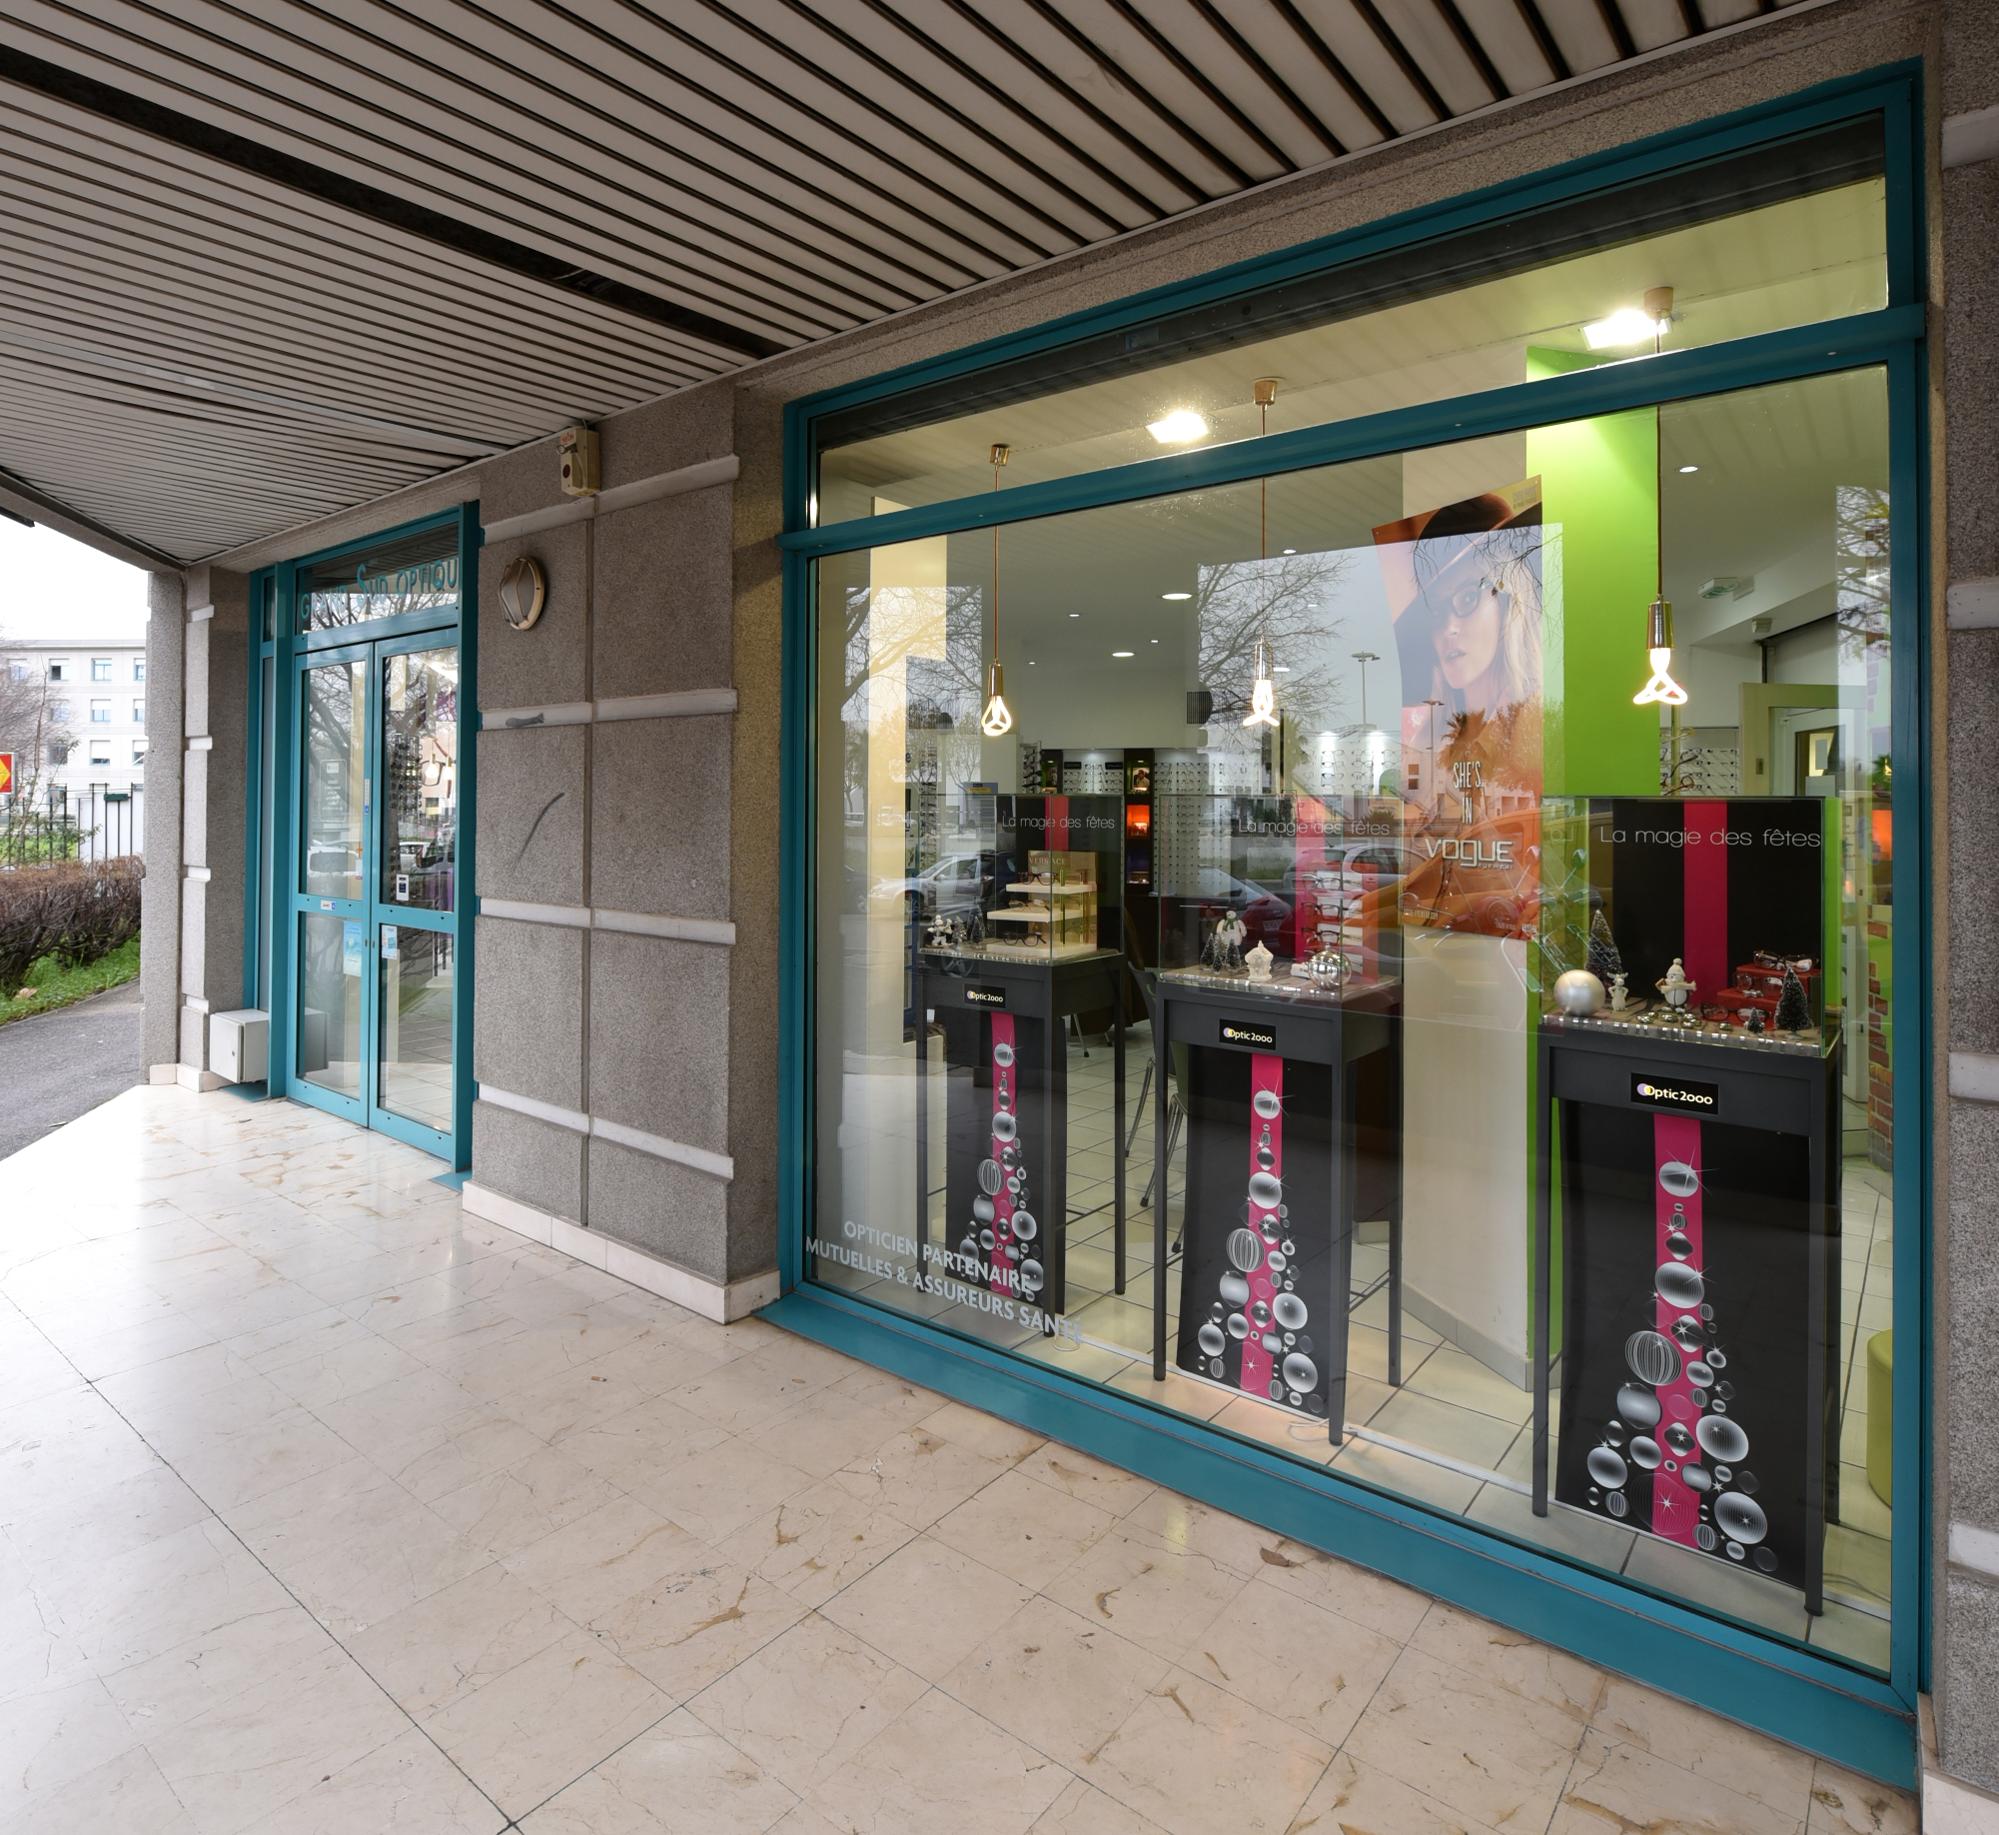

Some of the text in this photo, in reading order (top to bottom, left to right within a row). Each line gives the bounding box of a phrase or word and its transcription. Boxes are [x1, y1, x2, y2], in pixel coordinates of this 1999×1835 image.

[396, 557, 458, 598] OPTIQU
[1453, 761, 1481, 824] SHE'S IN
[1002, 816, 1115, 830] La magie des fêtes
[1238, 820, 1390, 836] La magie des fêtes
[1600, 826, 1821, 848] La magie des fêtes
[1251, 1032, 1273, 1043] 2000
[1680, 1090, 1713, 1105] 2000
[843, 1220, 1031, 1294] OPTICIEN PARTENAIRE
[805, 1235, 892, 1280] MUTUELLES
[896, 1266, 909, 1285] &
[912, 1271, 1015, 1321] ASSUREURS
